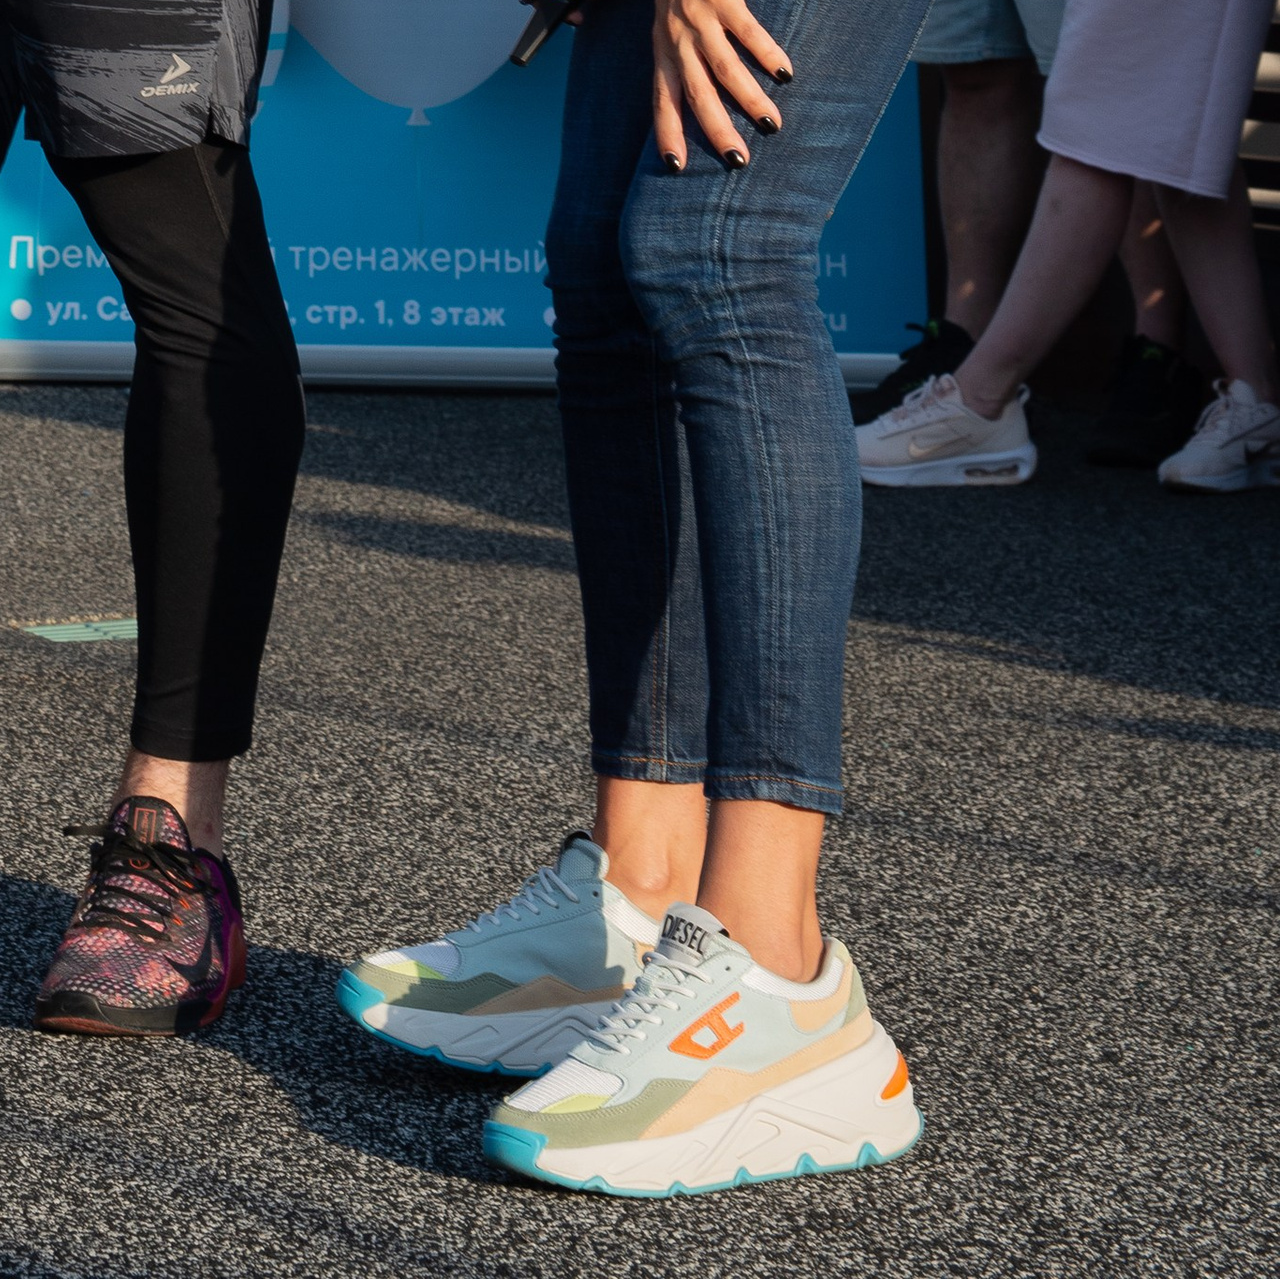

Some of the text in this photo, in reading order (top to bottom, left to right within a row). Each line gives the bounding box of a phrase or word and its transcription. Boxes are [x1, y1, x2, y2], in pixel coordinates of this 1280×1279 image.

[140, 82, 200, 98] DEMIX
[9, 235, 111, 276] Прем
[46, 301, 88, 326] ул.
[96, 295, 133, 321] Са
[305, 304, 366, 330] стр.
[374, 299, 394, 326] 1,
[402, 299, 421, 325] 8
[430, 305, 506, 327] этаж
[661, 913, 707, 956] DIESEL
